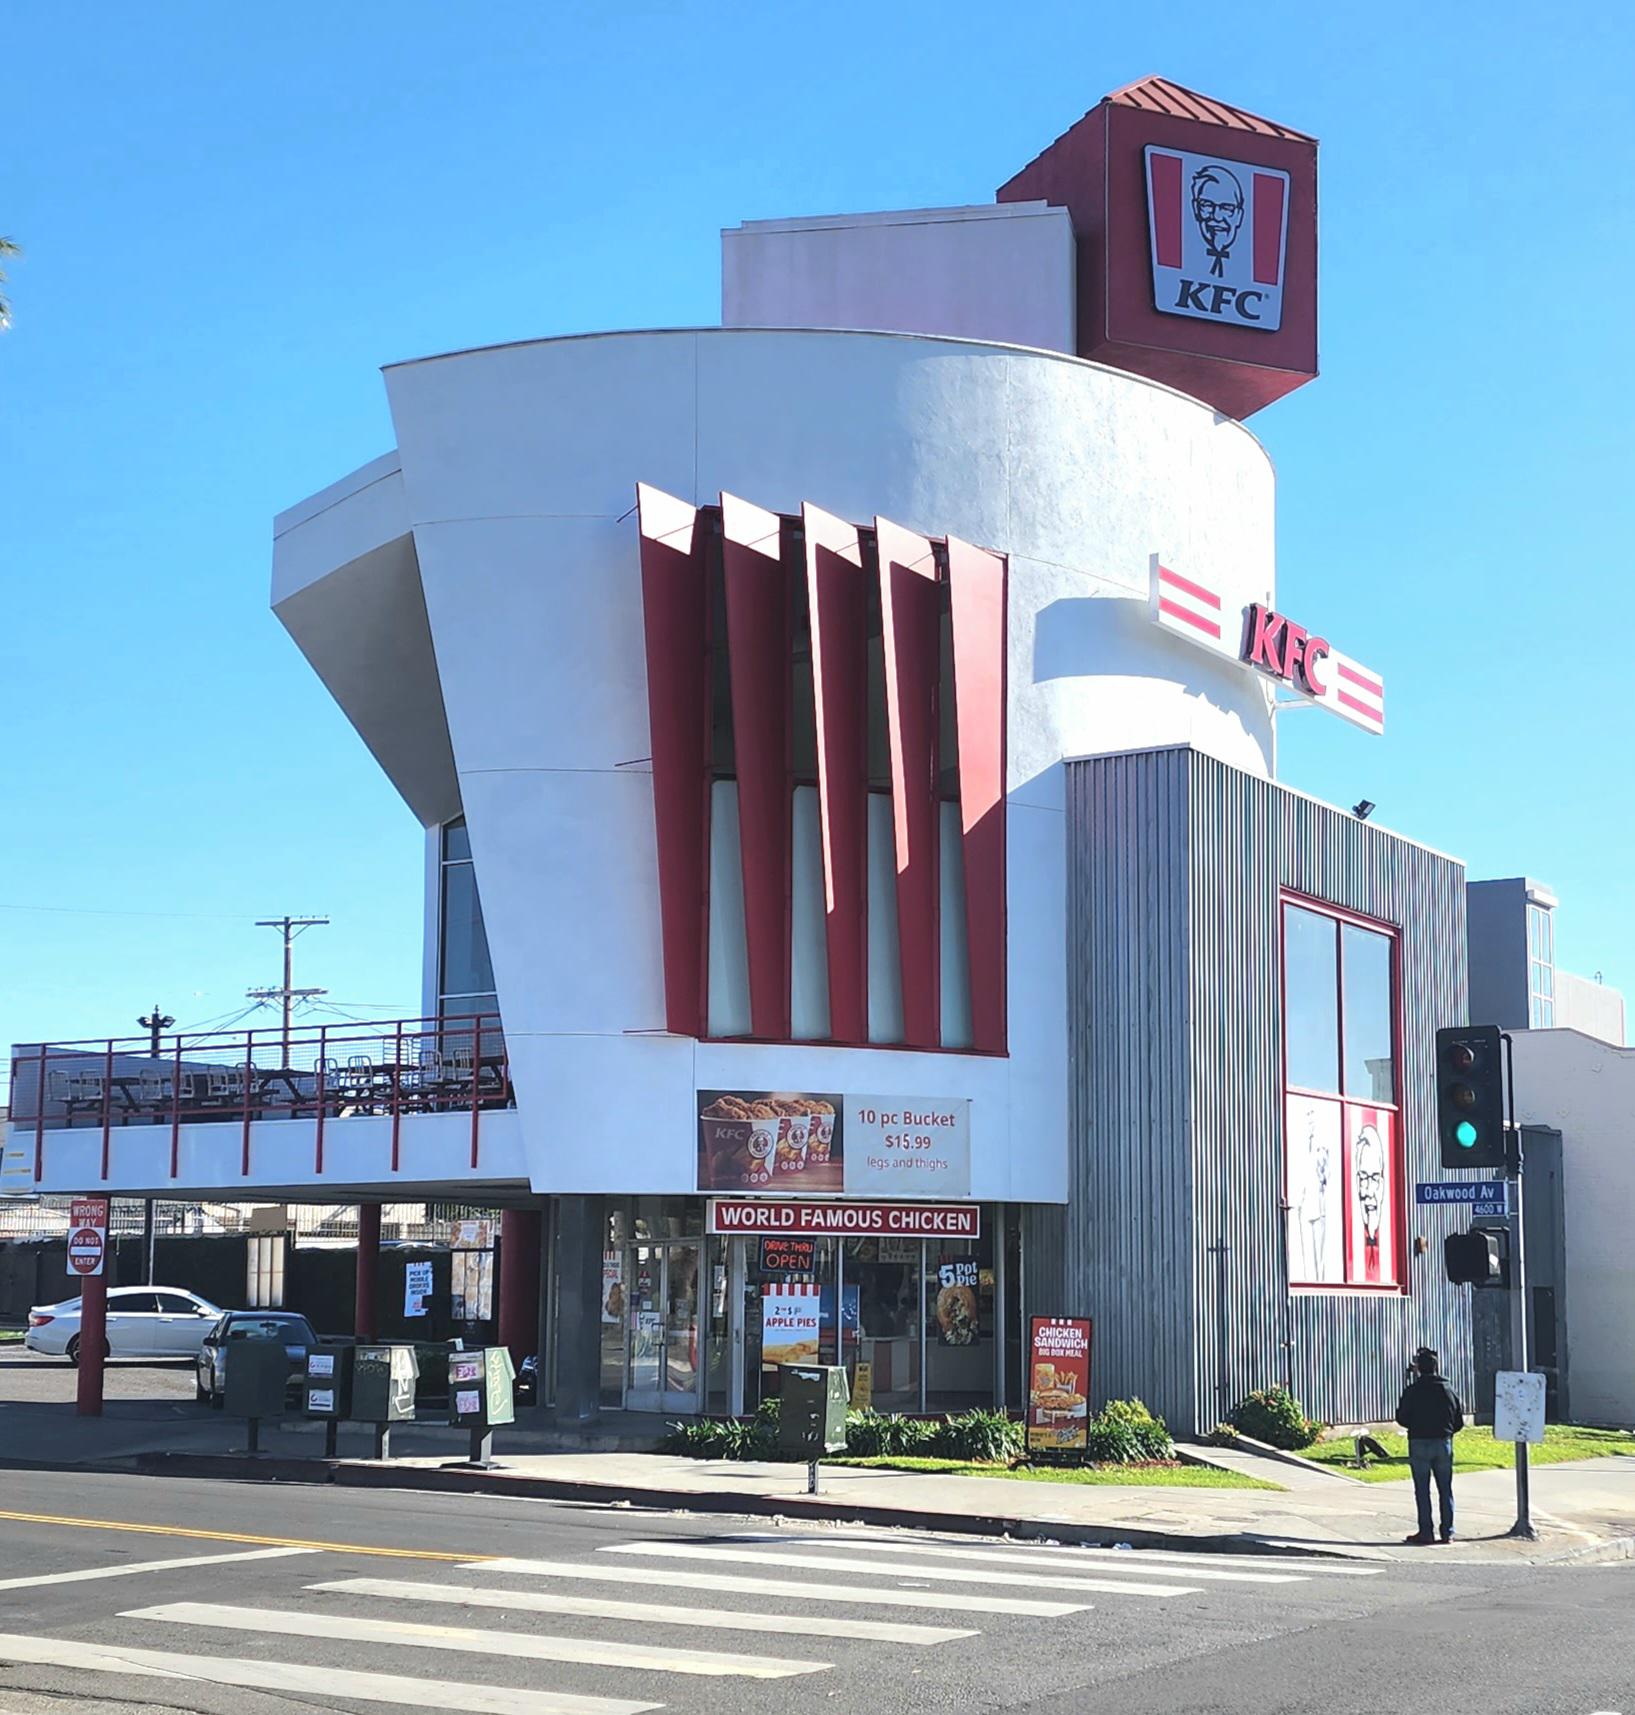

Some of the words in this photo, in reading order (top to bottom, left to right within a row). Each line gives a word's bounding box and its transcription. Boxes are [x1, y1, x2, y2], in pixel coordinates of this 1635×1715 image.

[1174, 279, 1263, 320] KFC
[1247, 603, 1330, 696] KFC
[858, 1110, 876, 1124] 10
[880, 1112, 898, 1128] pc
[903, 1111, 955, 1127] Bucket
[715, 1127, 745, 1140] KFC
[885, 1133, 931, 1149] $15.99
[867, 1156, 889, 1170] legs
[892, 1157, 913, 1168] and
[915, 1157, 949, 1172] thighs
[1424, 1184, 1476, 1200] Oakwood
[1480, 1184, 1494, 1199] Av
[72, 1205, 104, 1217] WRONG
[1474, 1204, 1495, 1214] 4600
[78, 1218, 97, 1227] WAY
[721, 1207, 795, 1227] WORLD
[800, 1208, 882, 1229] FAMOUS
[888, 1211, 971, 1231] CHICKEN
[73, 1236, 84, 1245] DO
[85, 1236, 99, 1245] NOT
[764, 1240, 788, 1251] DRIVE
[790, 1242, 813, 1253] THRU
[74, 1257, 96, 1266] ENTER
[766, 1253, 810, 1269] OPEN
[766, 1317, 794, 1328] APPLE
[797, 1317, 817, 1328] PIES
[1038, 1326, 1082, 1339] CHICKEN
[1034, 1336, 1088, 1350] SANDWICH
[1038, 1347, 1050, 1357] BIG
[1051, 1348, 1064, 1358] BOX
[1065, 1349, 1082, 1358] MEAL
